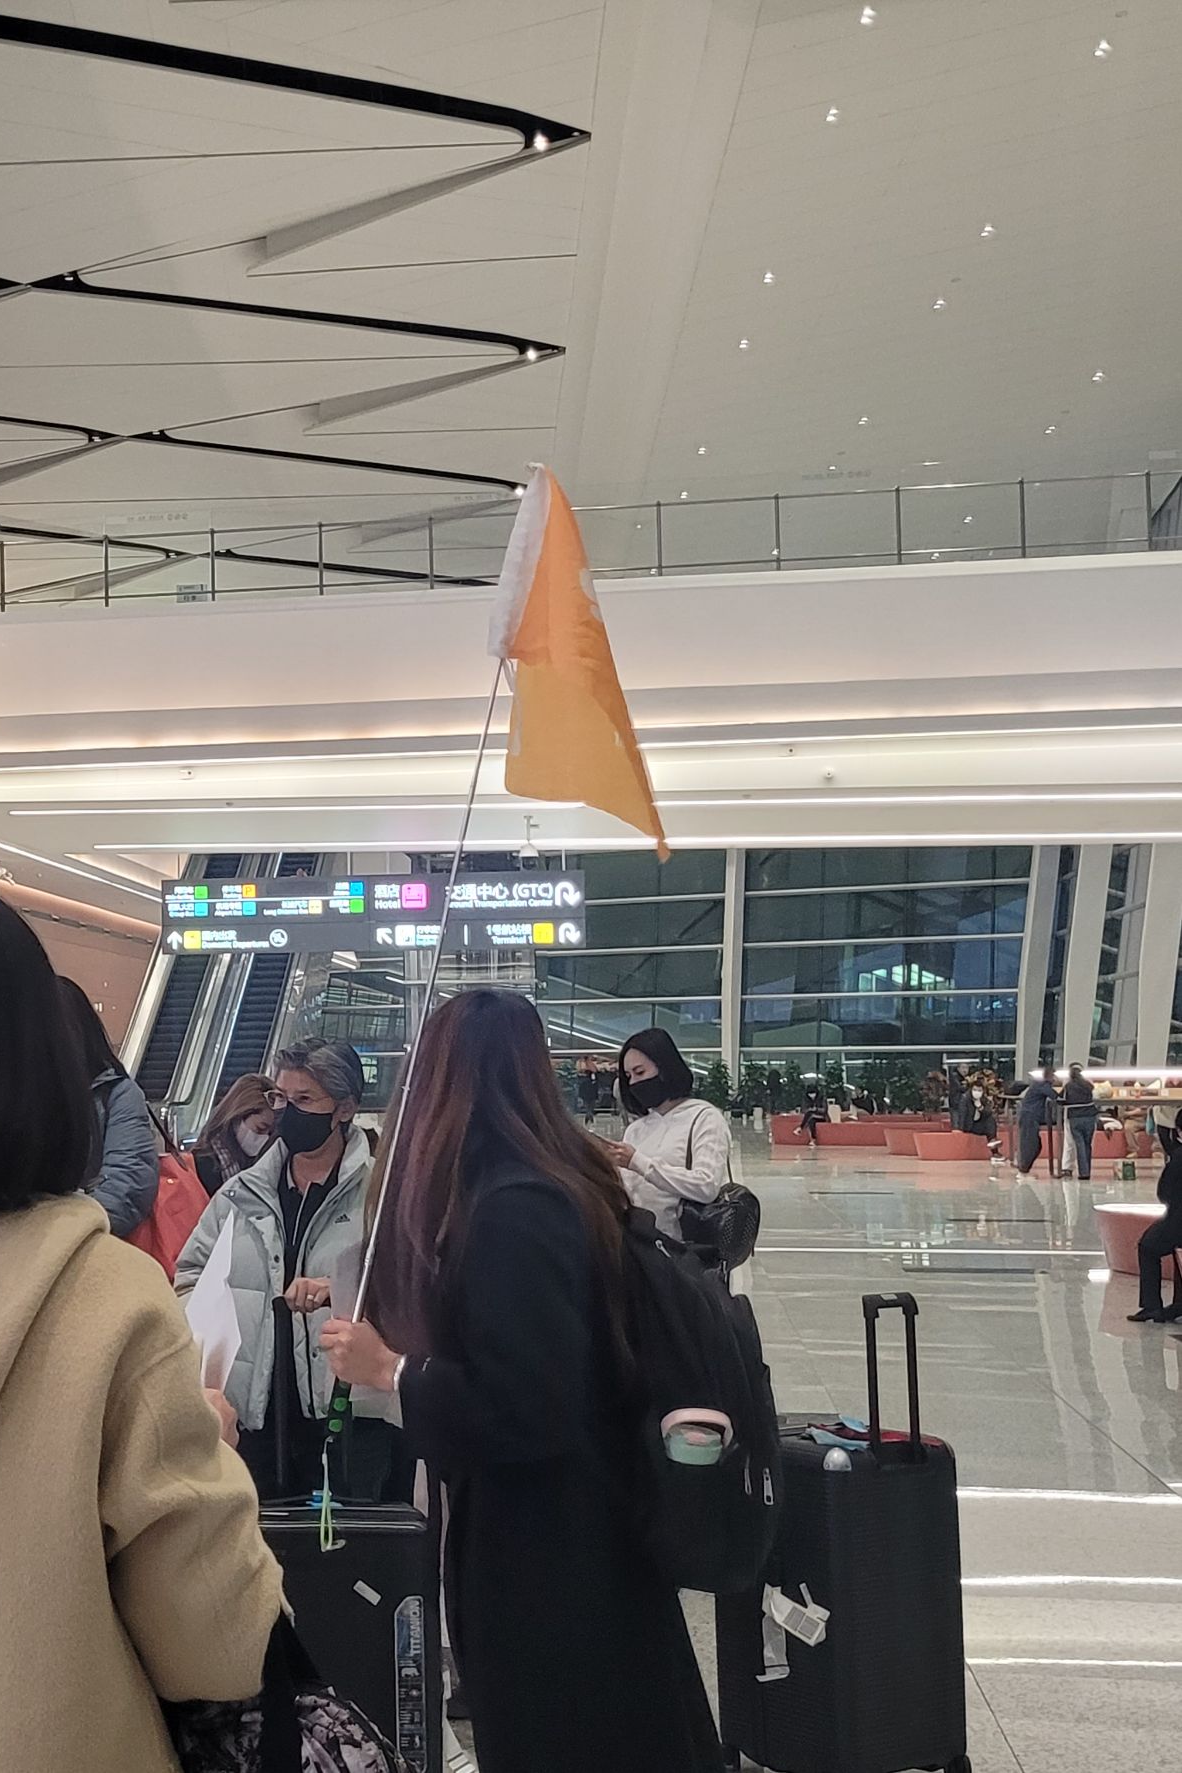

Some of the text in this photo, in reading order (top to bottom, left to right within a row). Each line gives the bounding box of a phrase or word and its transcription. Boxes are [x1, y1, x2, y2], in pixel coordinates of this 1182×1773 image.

[374, 884, 400, 898] 酒店
[513, 882, 554, 899] (GTC)
[374, 899, 401, 909] Hotel
[474, 900, 527, 909] Transportation
[528, 899, 553, 907] Center
[491, 935, 527, 944] Terminal
